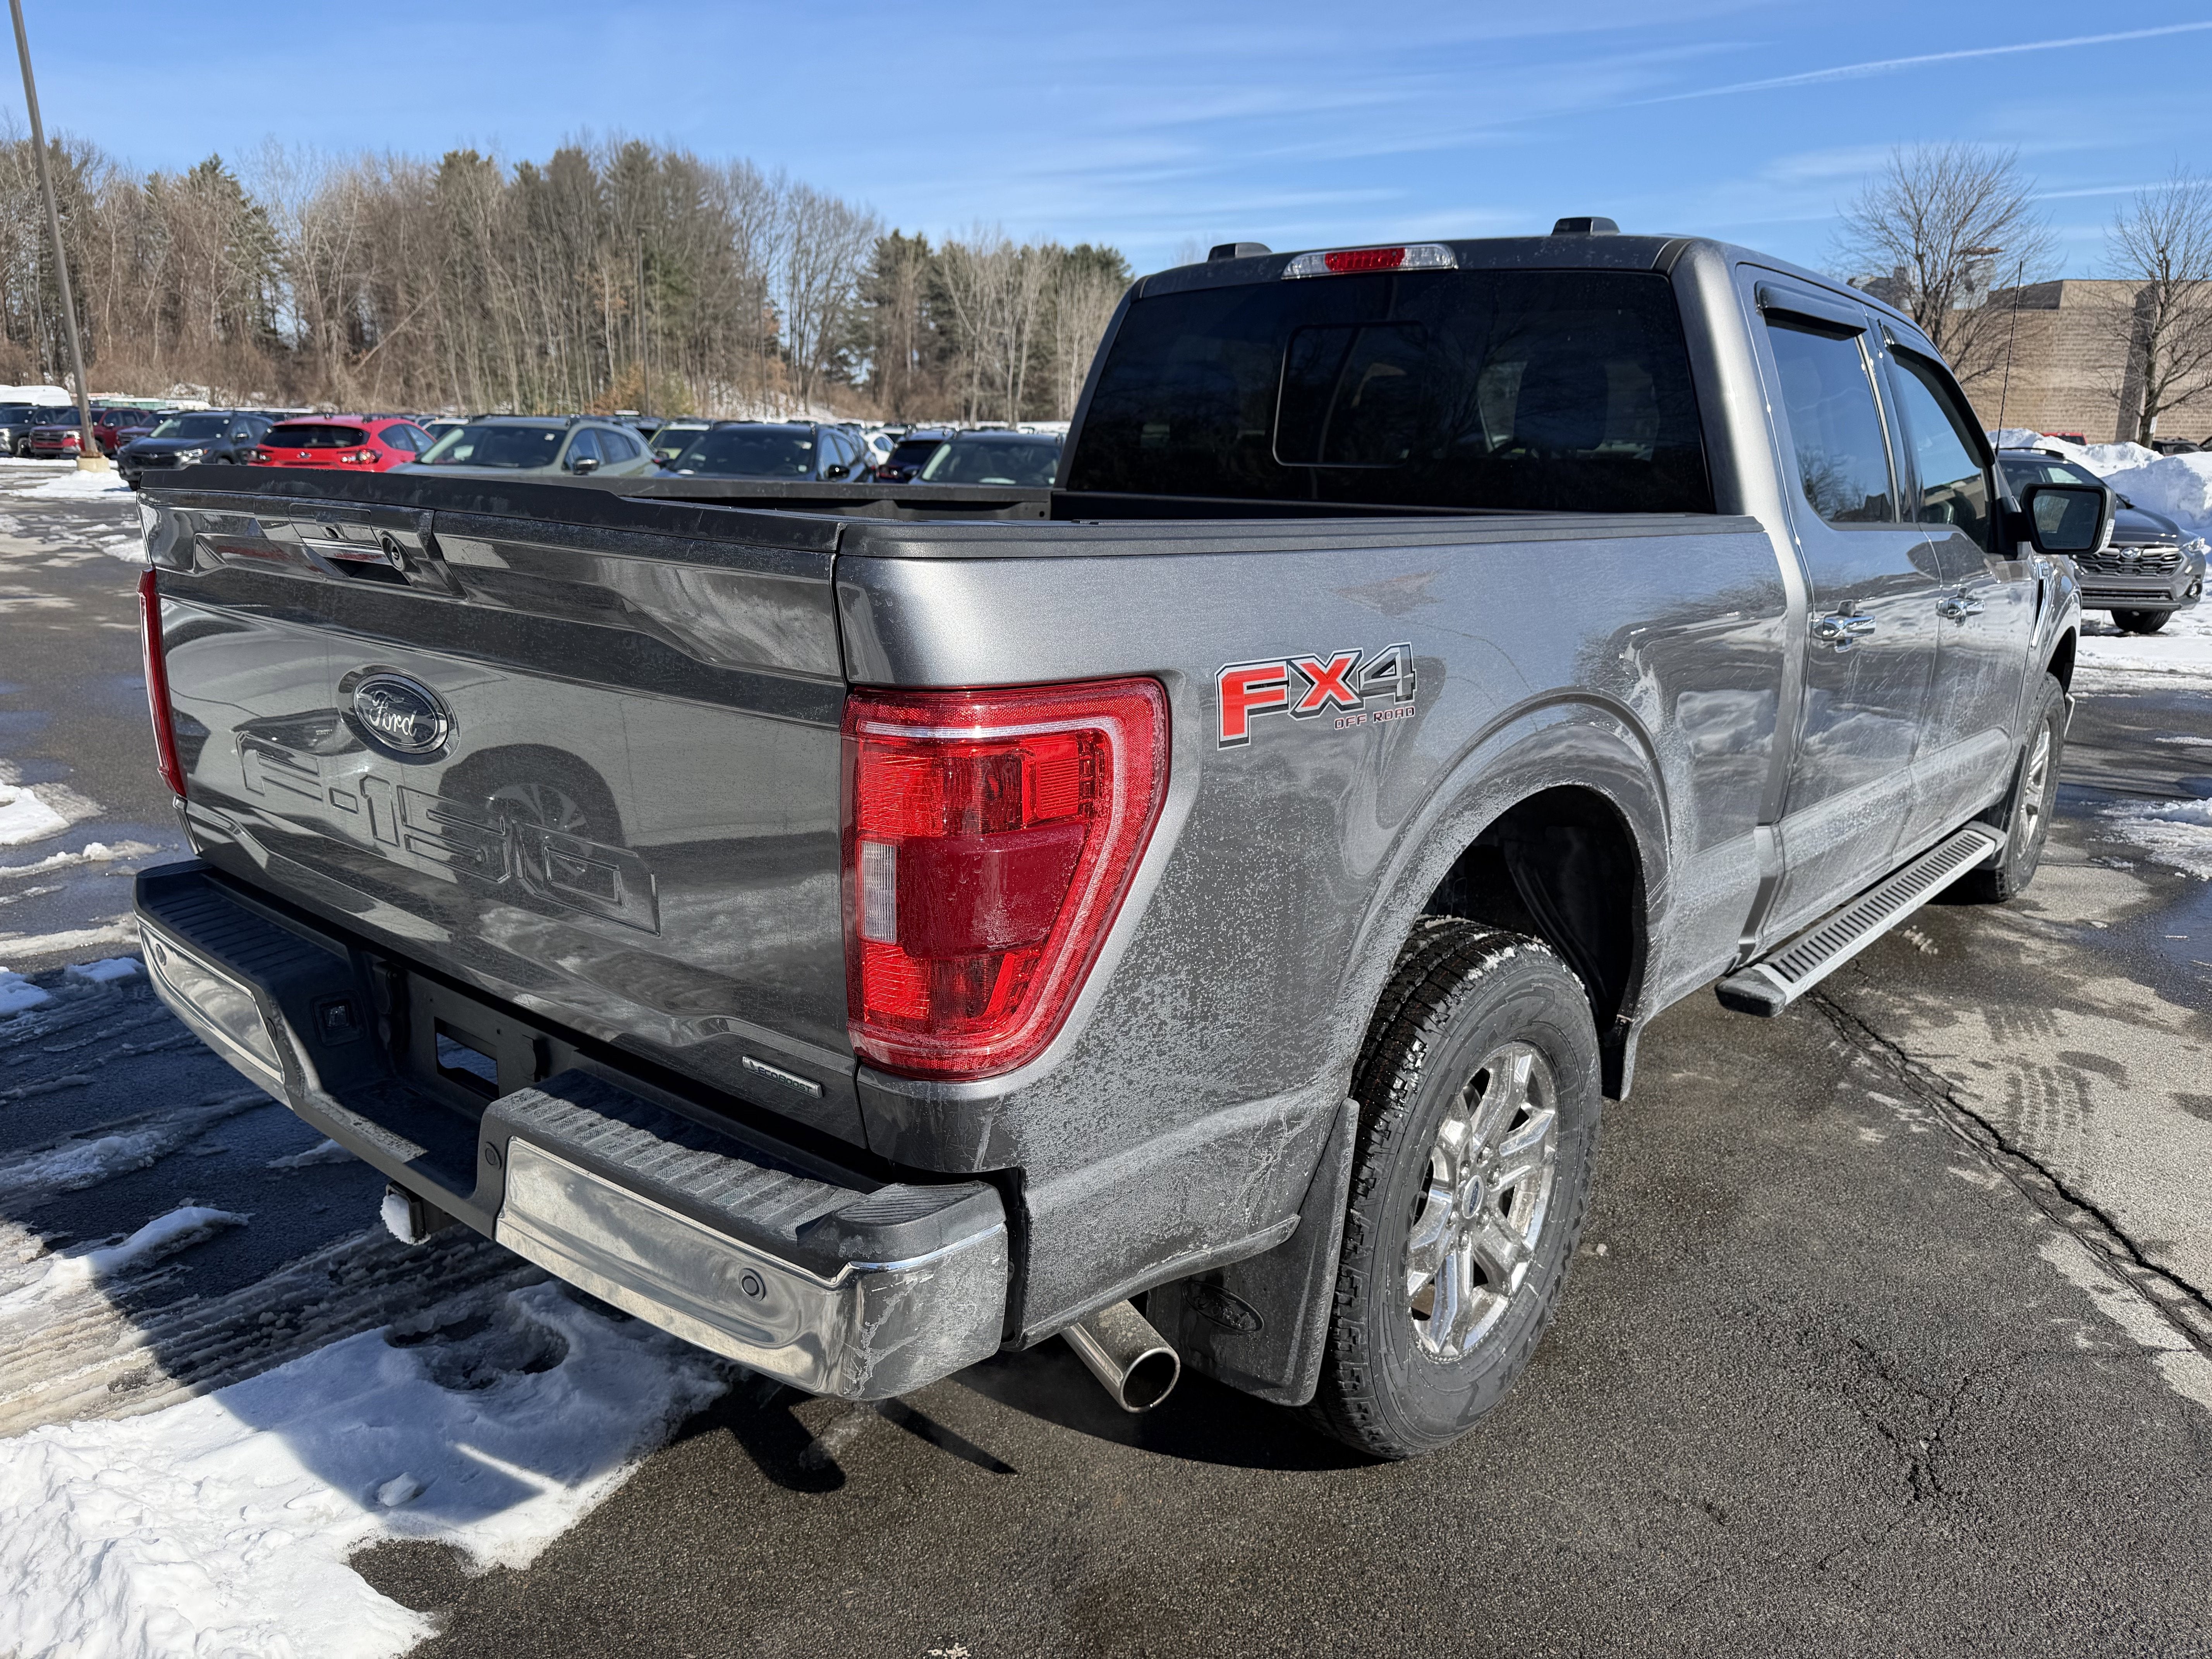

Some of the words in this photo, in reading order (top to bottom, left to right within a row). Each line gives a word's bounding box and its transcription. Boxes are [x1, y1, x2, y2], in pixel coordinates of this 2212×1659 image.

[369, 690, 417, 737] Ford
[1214, 641, 1417, 751] FX4
[1334, 713, 1367, 730] OFF
[1372, 706, 1415, 723] ROAD
[235, 730, 661, 938] F-150
